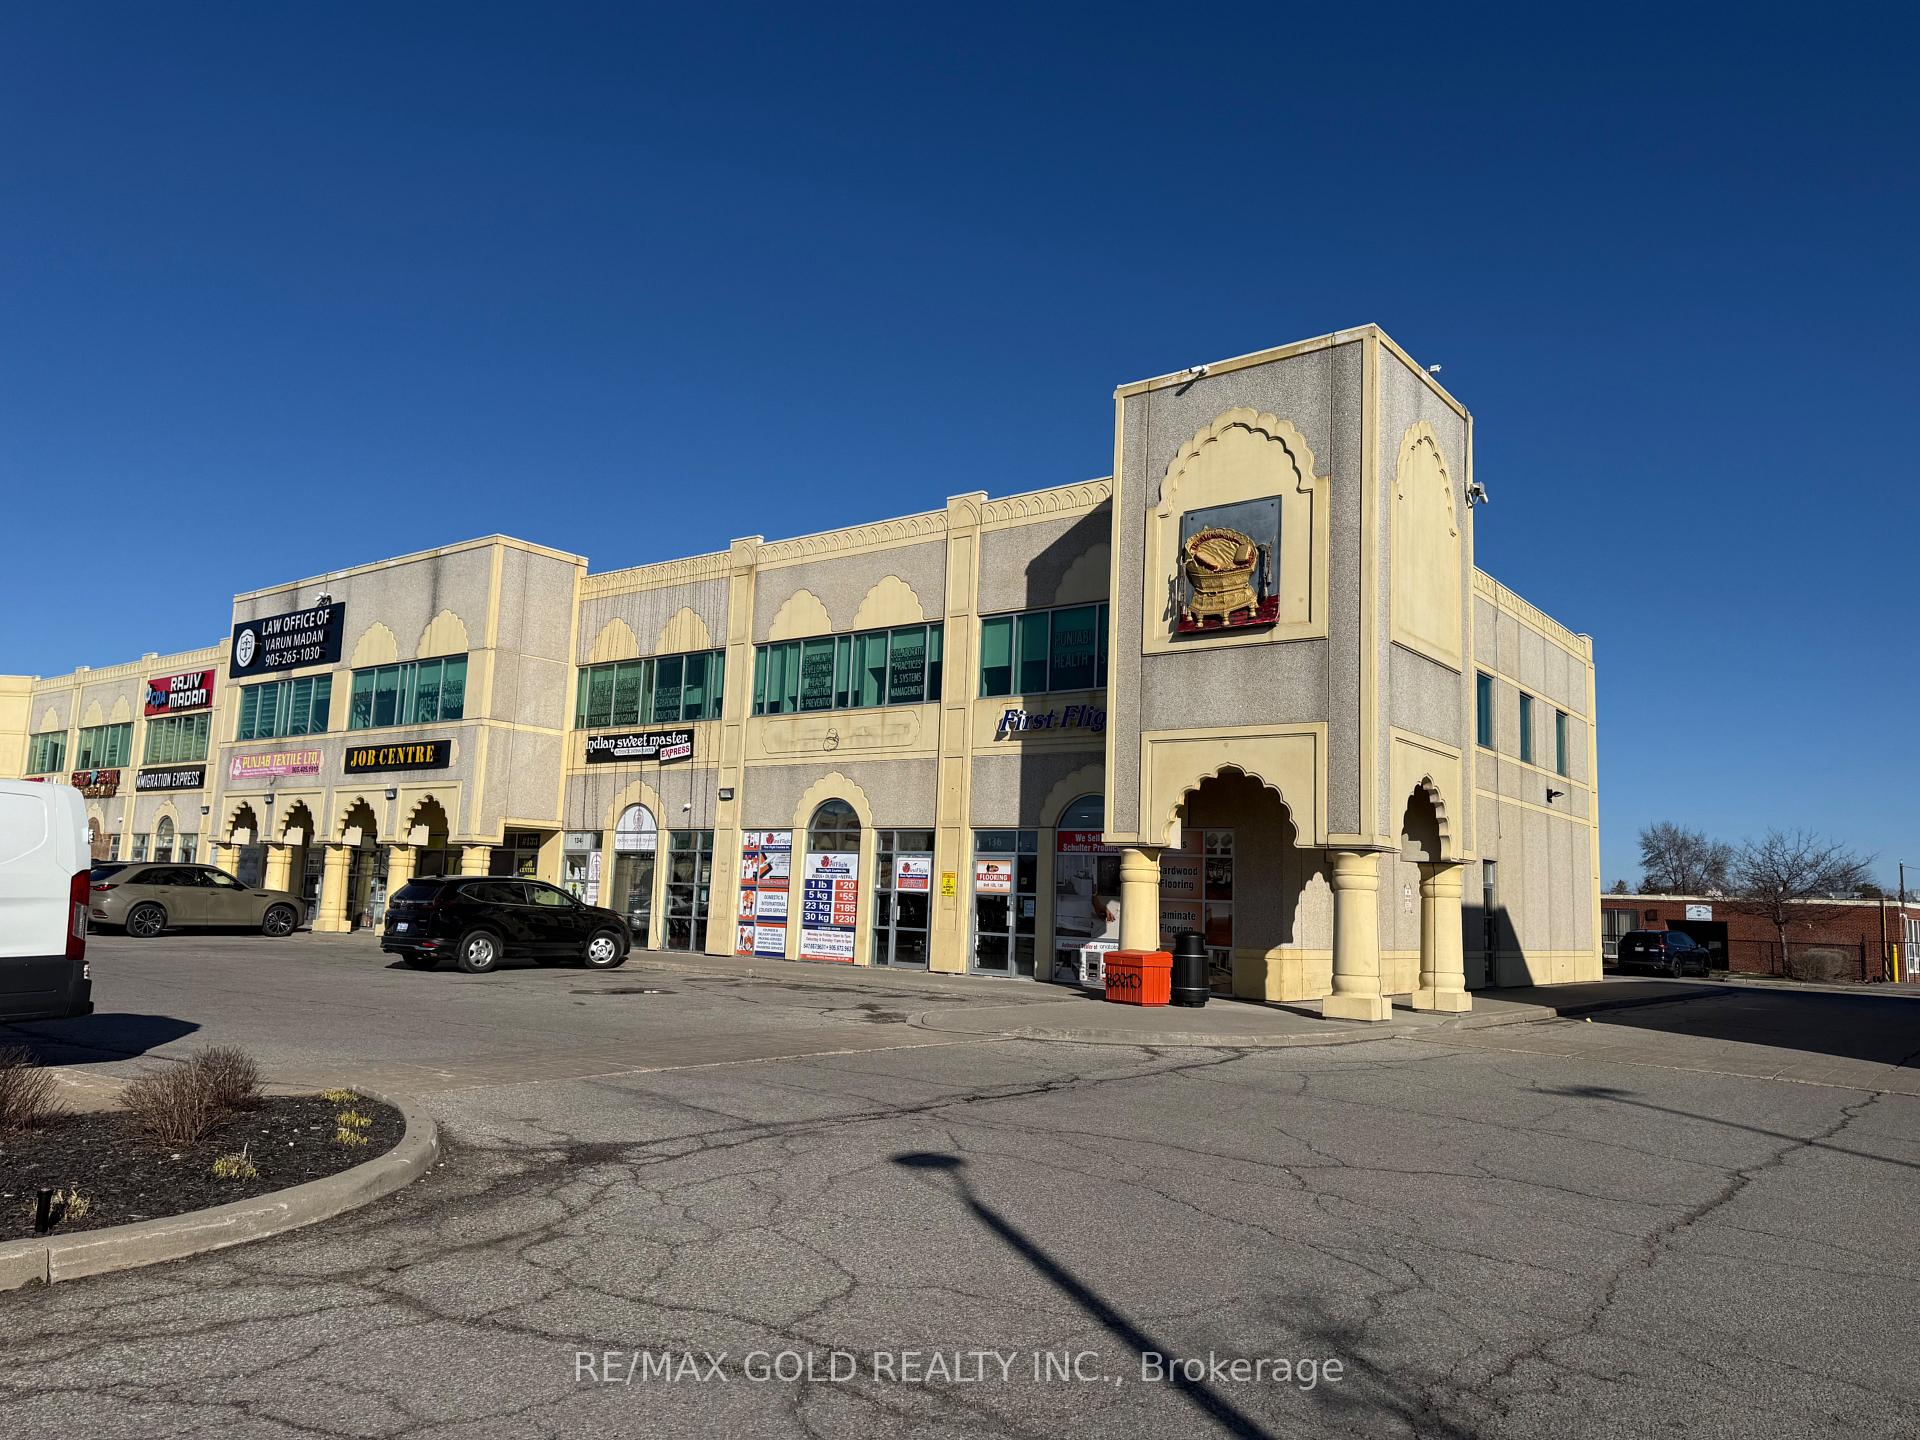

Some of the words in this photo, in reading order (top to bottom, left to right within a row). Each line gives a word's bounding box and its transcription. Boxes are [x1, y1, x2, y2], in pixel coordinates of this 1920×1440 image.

[262, 618, 282, 635] LAW
[283, 611, 315, 631] OFFICE
[316, 609, 330, 625] OF
[265, 635, 293, 651] VARUN
[293, 629, 324, 647] MADAN
[265, 646, 320, 667] 905-265-1030
[170, 672, 202, 691] RAJIV
[168, 688, 207, 708] MADAN
[890, 685, 924, 697] MANAGEMENT
[1000, 709, 1056, 732] First
[616, 734, 648, 748] sweet
[649, 731, 689, 750] master
[350, 749, 376, 767] JOB
[379, 745, 435, 765] CENTRE
[661, 744, 690, 758] EXPRESS
[242, 755, 271, 769] PUNJAB
[272, 752, 302, 766] TEXTILE
[172, 770, 200, 786] EXPRESS
[1075, 833, 1087, 842] We
[1087, 833, 1101, 842] Sell
[818, 880, 827, 888] lb
[840, 881, 855, 889] $20
[979, 873, 1008, 881] FLOORING
[1160, 879, 1194, 891] Flooring
[809, 890, 815, 898] 5
[817, 890, 828, 900] kg
[840, 892, 854, 900] $55
[805, 901, 816, 909] 23
[819, 901, 830, 912] kg
[836, 904, 856, 912] $185
[818, 913, 829, 923] kg
[835, 915, 856, 923] $230
